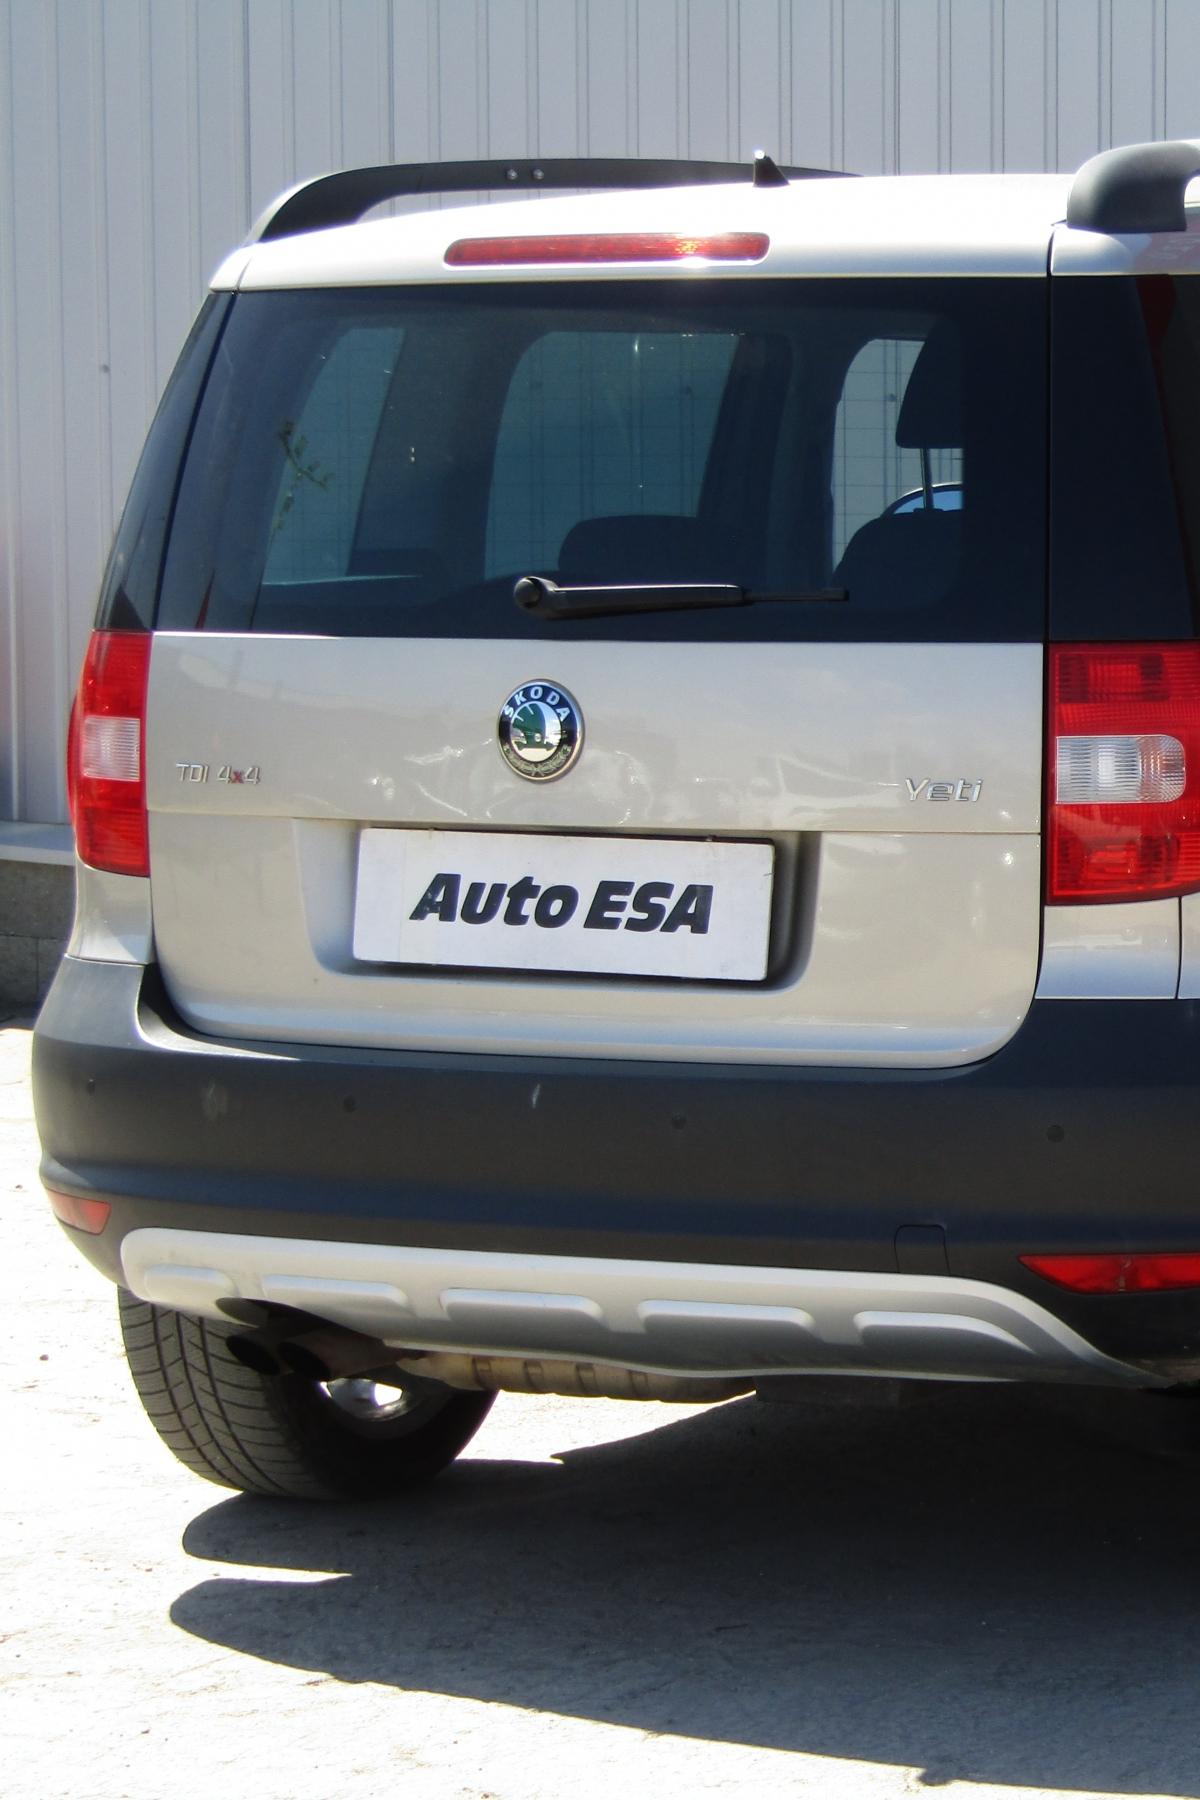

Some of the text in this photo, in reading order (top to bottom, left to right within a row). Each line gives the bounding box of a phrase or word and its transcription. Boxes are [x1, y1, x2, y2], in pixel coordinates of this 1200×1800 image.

[175, 763, 261, 785] TDI 4x4
[905, 777, 984, 802] Yeti
[409, 872, 714, 935] Auto ESA
